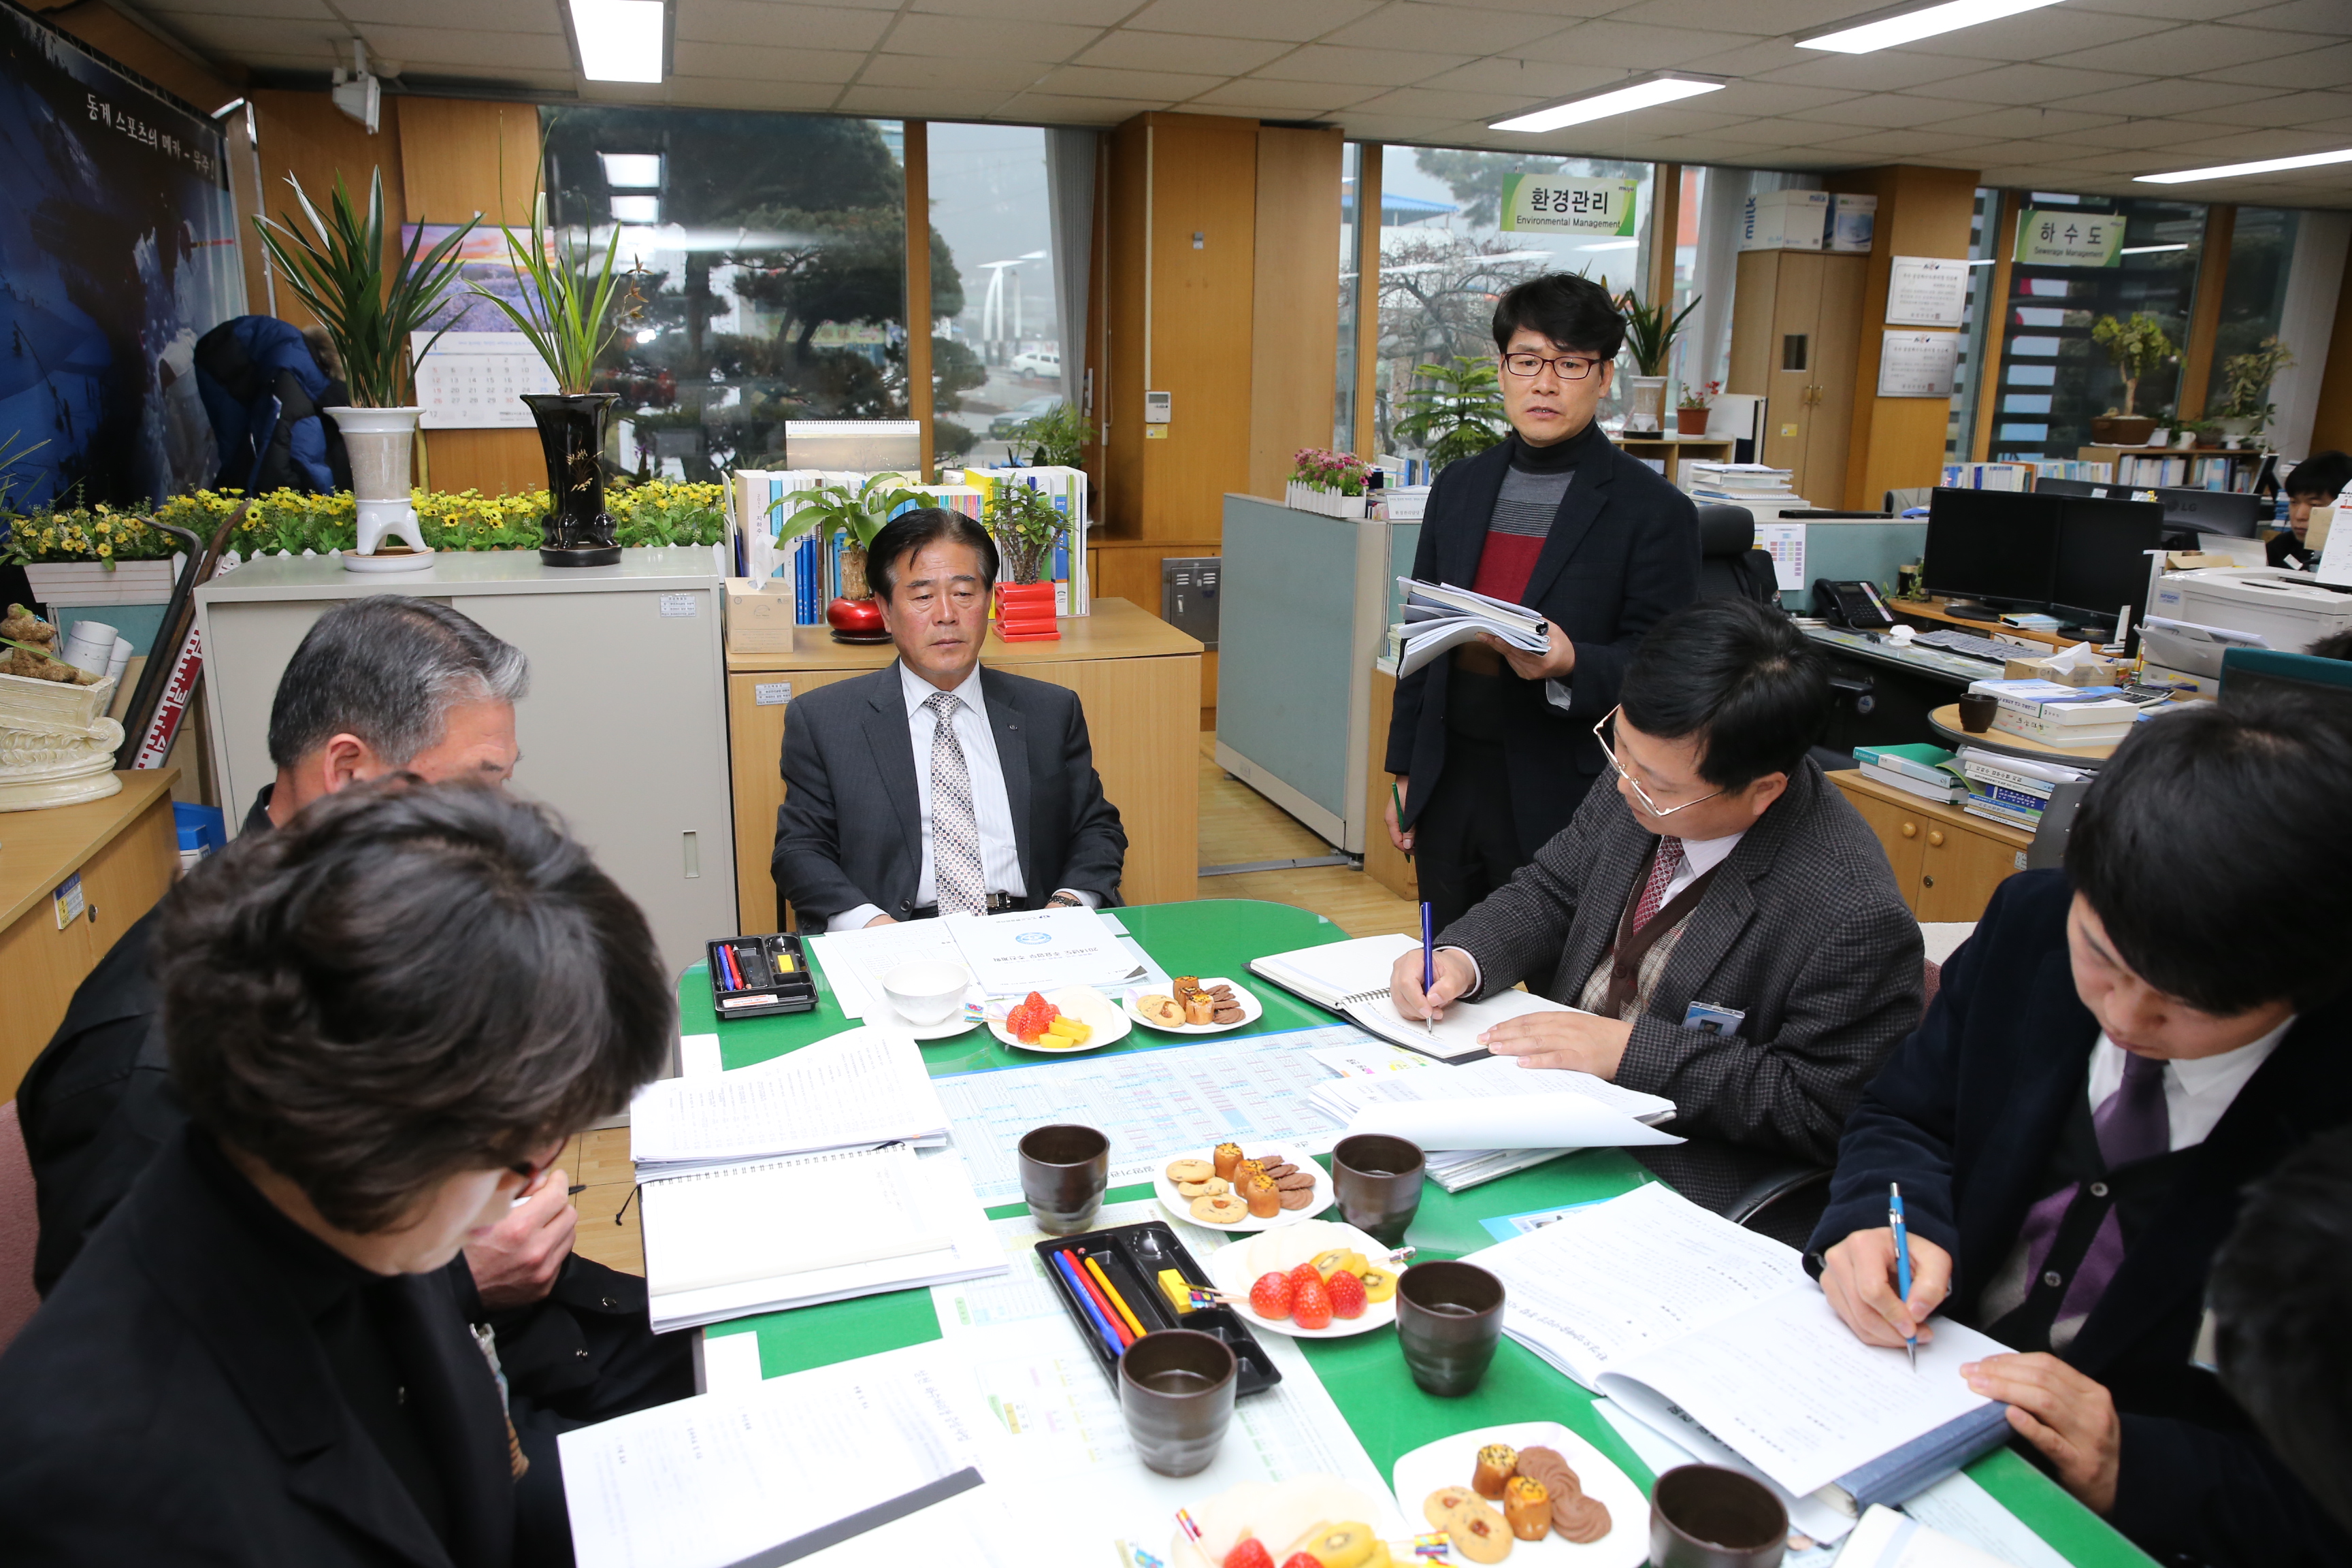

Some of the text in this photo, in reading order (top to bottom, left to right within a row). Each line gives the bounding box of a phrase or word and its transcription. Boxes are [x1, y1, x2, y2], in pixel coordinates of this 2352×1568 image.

[87, 93, 110, 127] 동계
[116, 111, 157, 151] 스포츠의
[162, 134, 181, 160] 메카
[1531, 188, 1607, 214] 환경관리
[1517, 215, 1620, 229] Environmental Management
[2041, 222, 2102, 244] 하수도
[2035, 246, 2104, 258] Sewerage Management
[2180, 503, 2197, 512] LG
[154, 735, 167, 751] 4
[1029, 951, 1060, 959] 주요업무
[1064, 947, 1099, 956] 2014년도
[993, 954, 1025, 962] 추진계획
[1109, 1166, 1154, 1178] 일망기관
